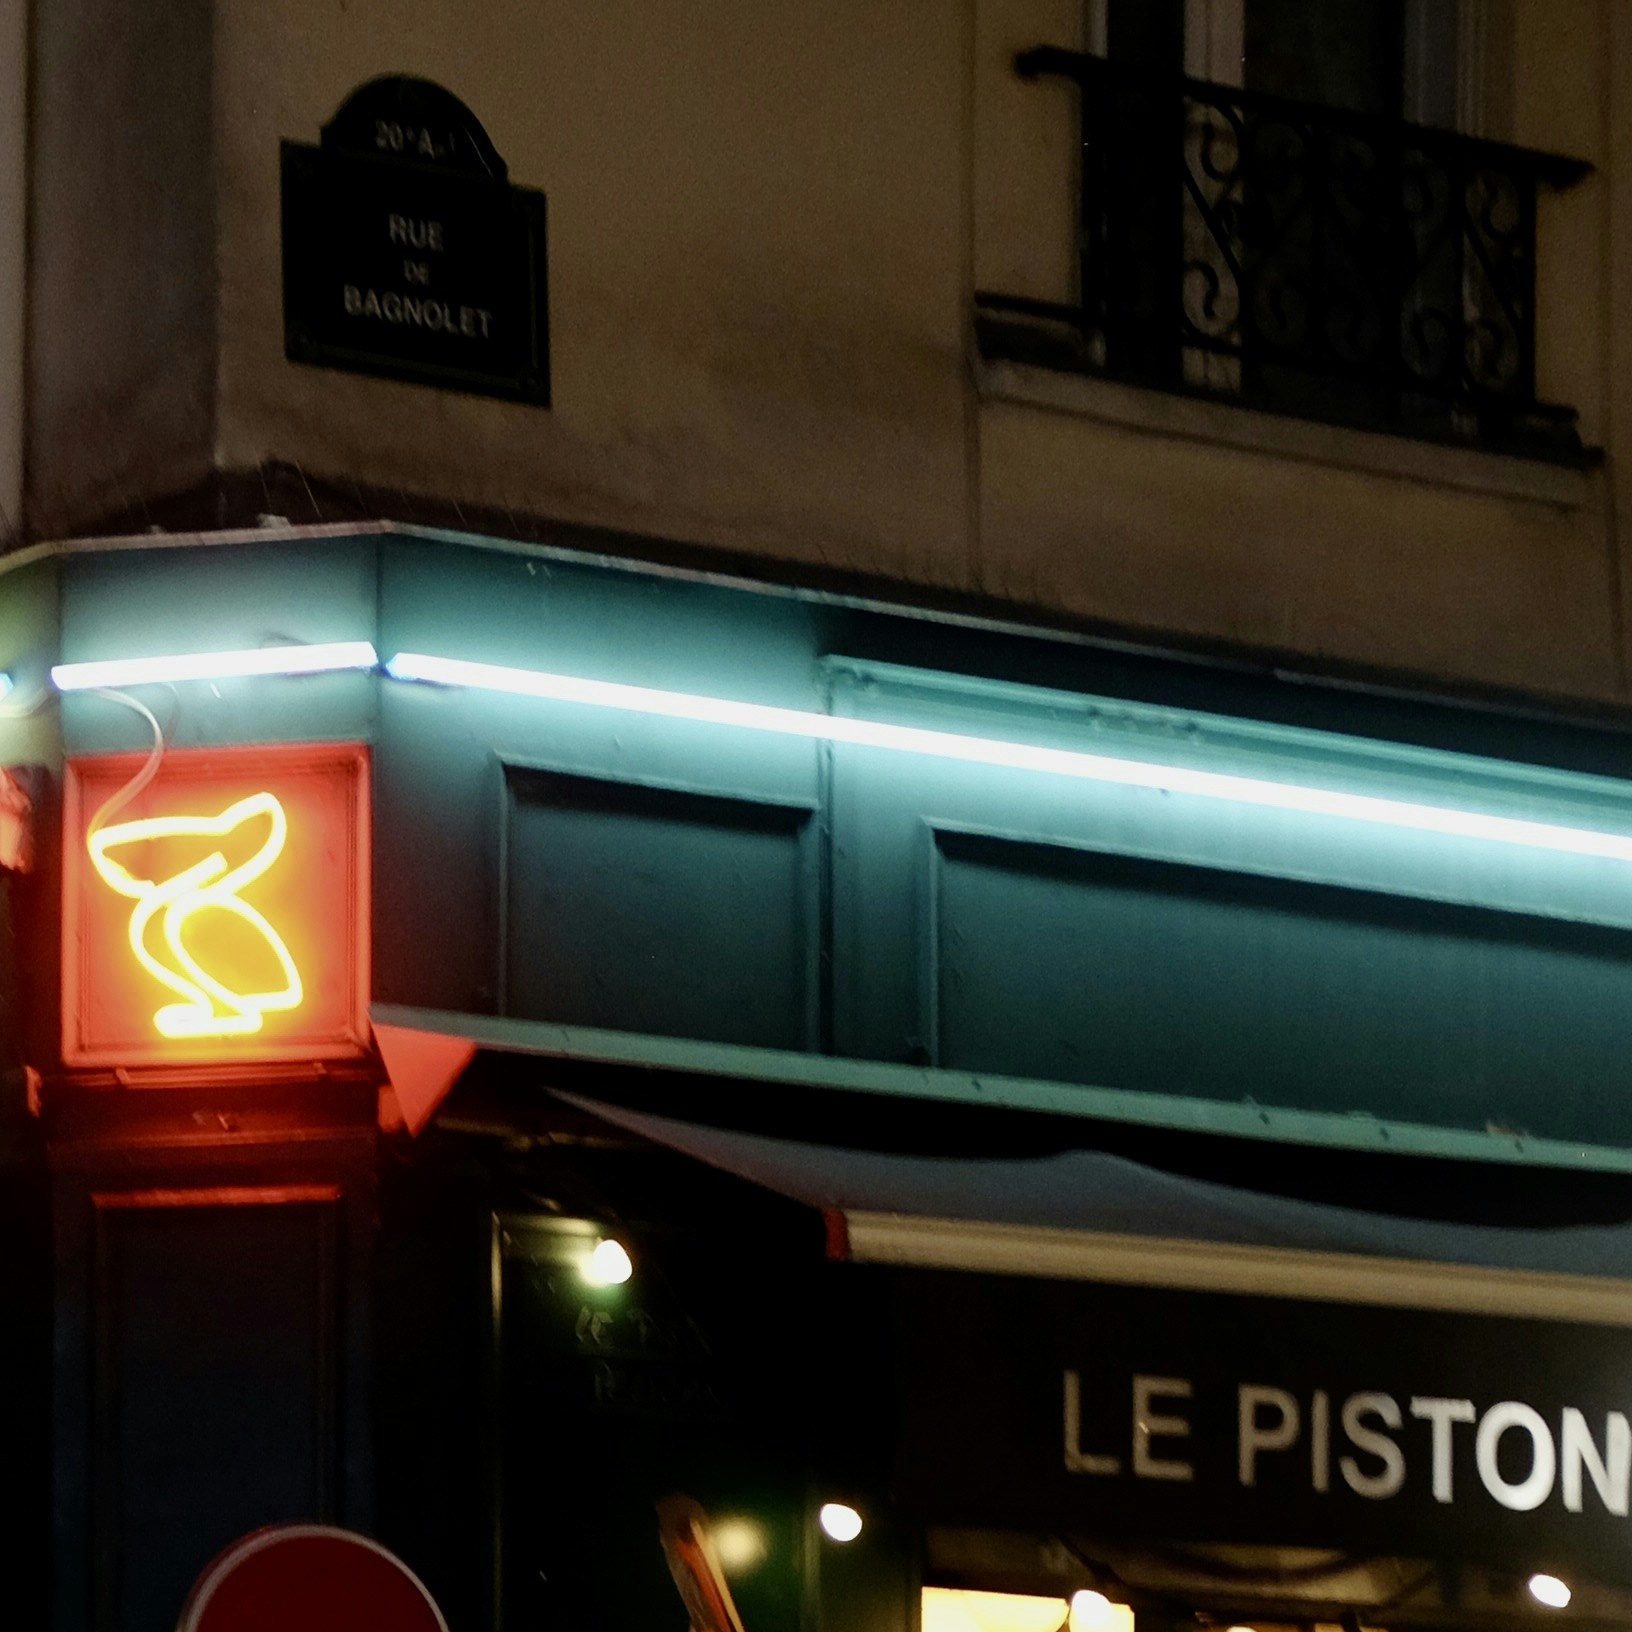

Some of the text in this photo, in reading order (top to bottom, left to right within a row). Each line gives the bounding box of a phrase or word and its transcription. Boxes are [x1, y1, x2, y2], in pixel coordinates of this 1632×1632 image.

[387, 211, 445, 253] RUE
[403, 258, 431, 287] DE
[343, 282, 494, 340] BAGNOLET
[1063, 1368, 1631, 1517] LE PISTON
